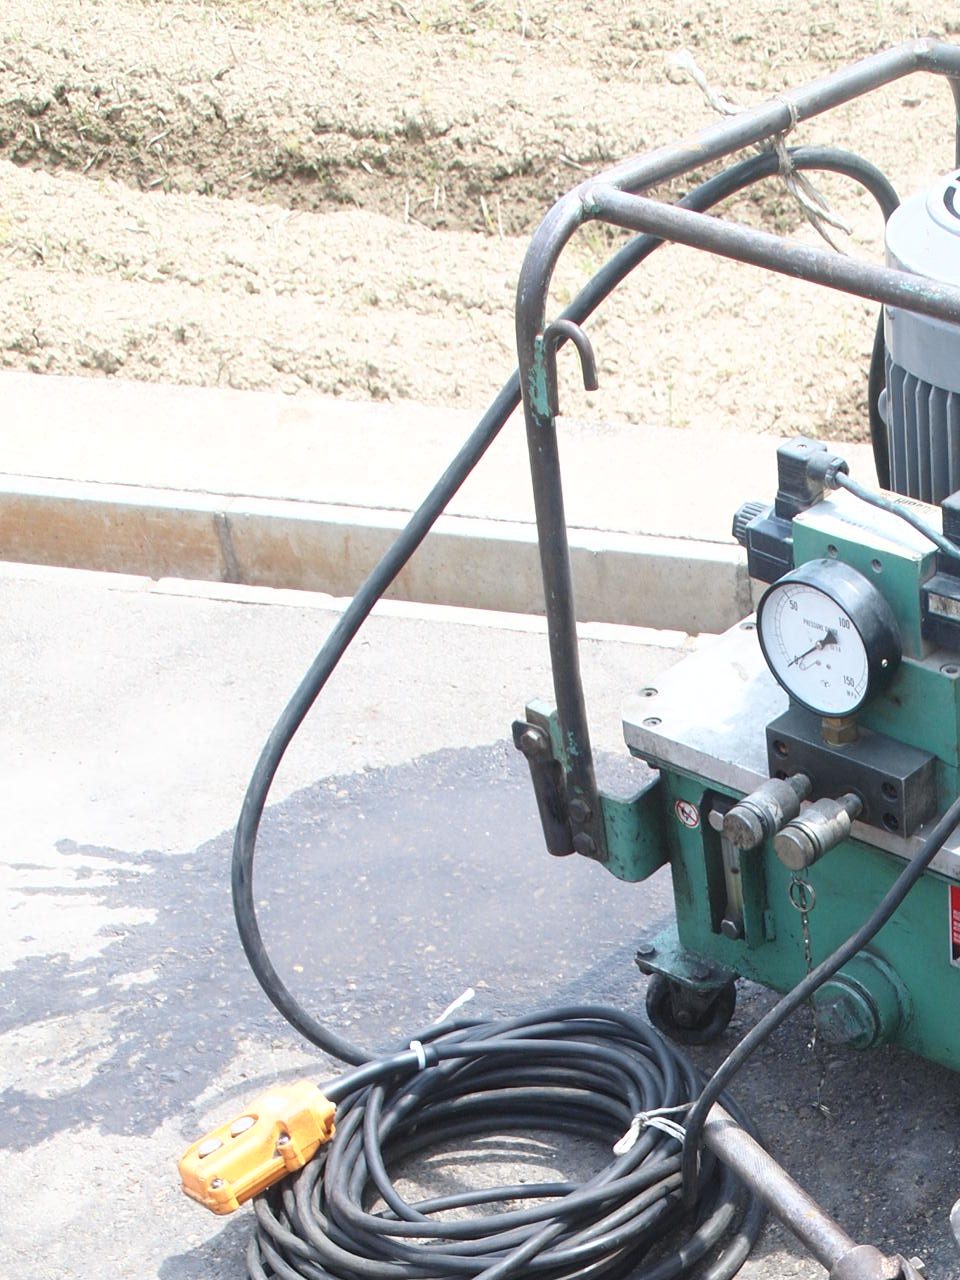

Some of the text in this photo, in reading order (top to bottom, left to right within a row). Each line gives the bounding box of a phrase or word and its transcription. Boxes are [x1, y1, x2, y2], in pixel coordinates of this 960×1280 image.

[789, 600, 799, 611] 50
[838, 616, 851, 630] 100
[843, 675, 855, 688] 150
